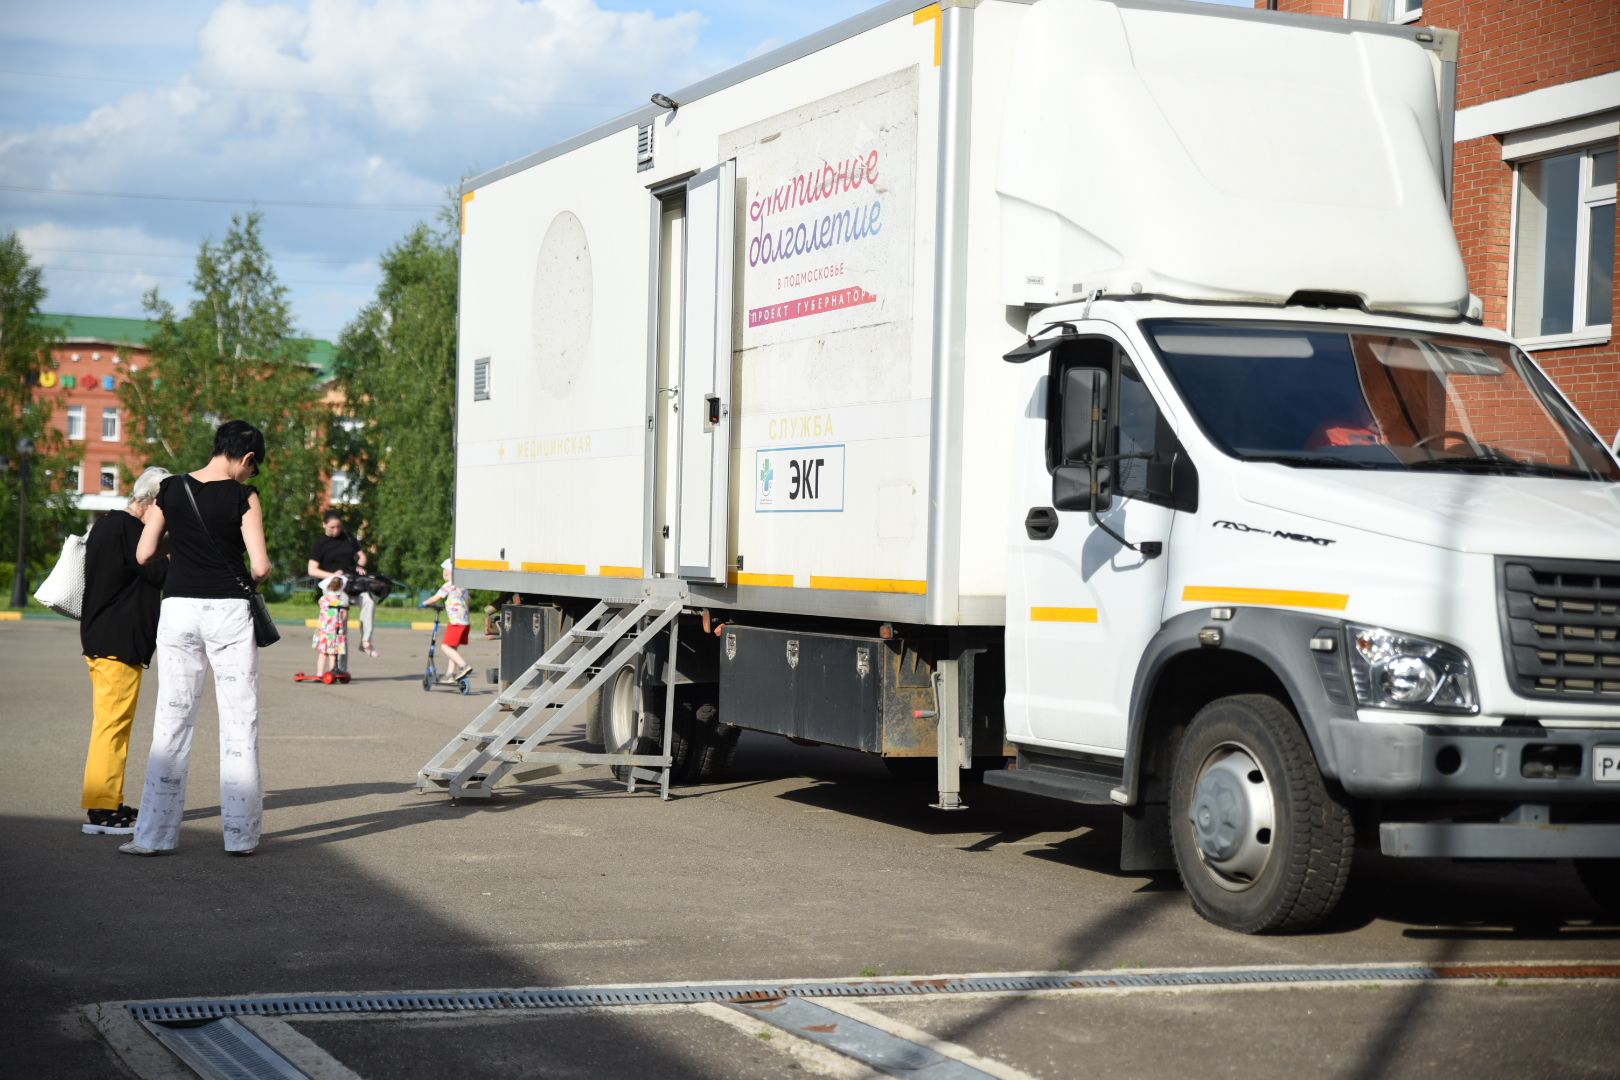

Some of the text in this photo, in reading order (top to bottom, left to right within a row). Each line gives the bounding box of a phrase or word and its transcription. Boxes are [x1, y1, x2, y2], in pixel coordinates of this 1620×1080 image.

[749, 201, 884, 268] долголетие
[783, 262, 845, 289] ПОДМОСКОВЬЕ
[751, 304, 790, 323] ПРОЕКТ
[769, 414, 834, 440] СЛУЖБА
[789, 458, 825, 500] ЭКГ
